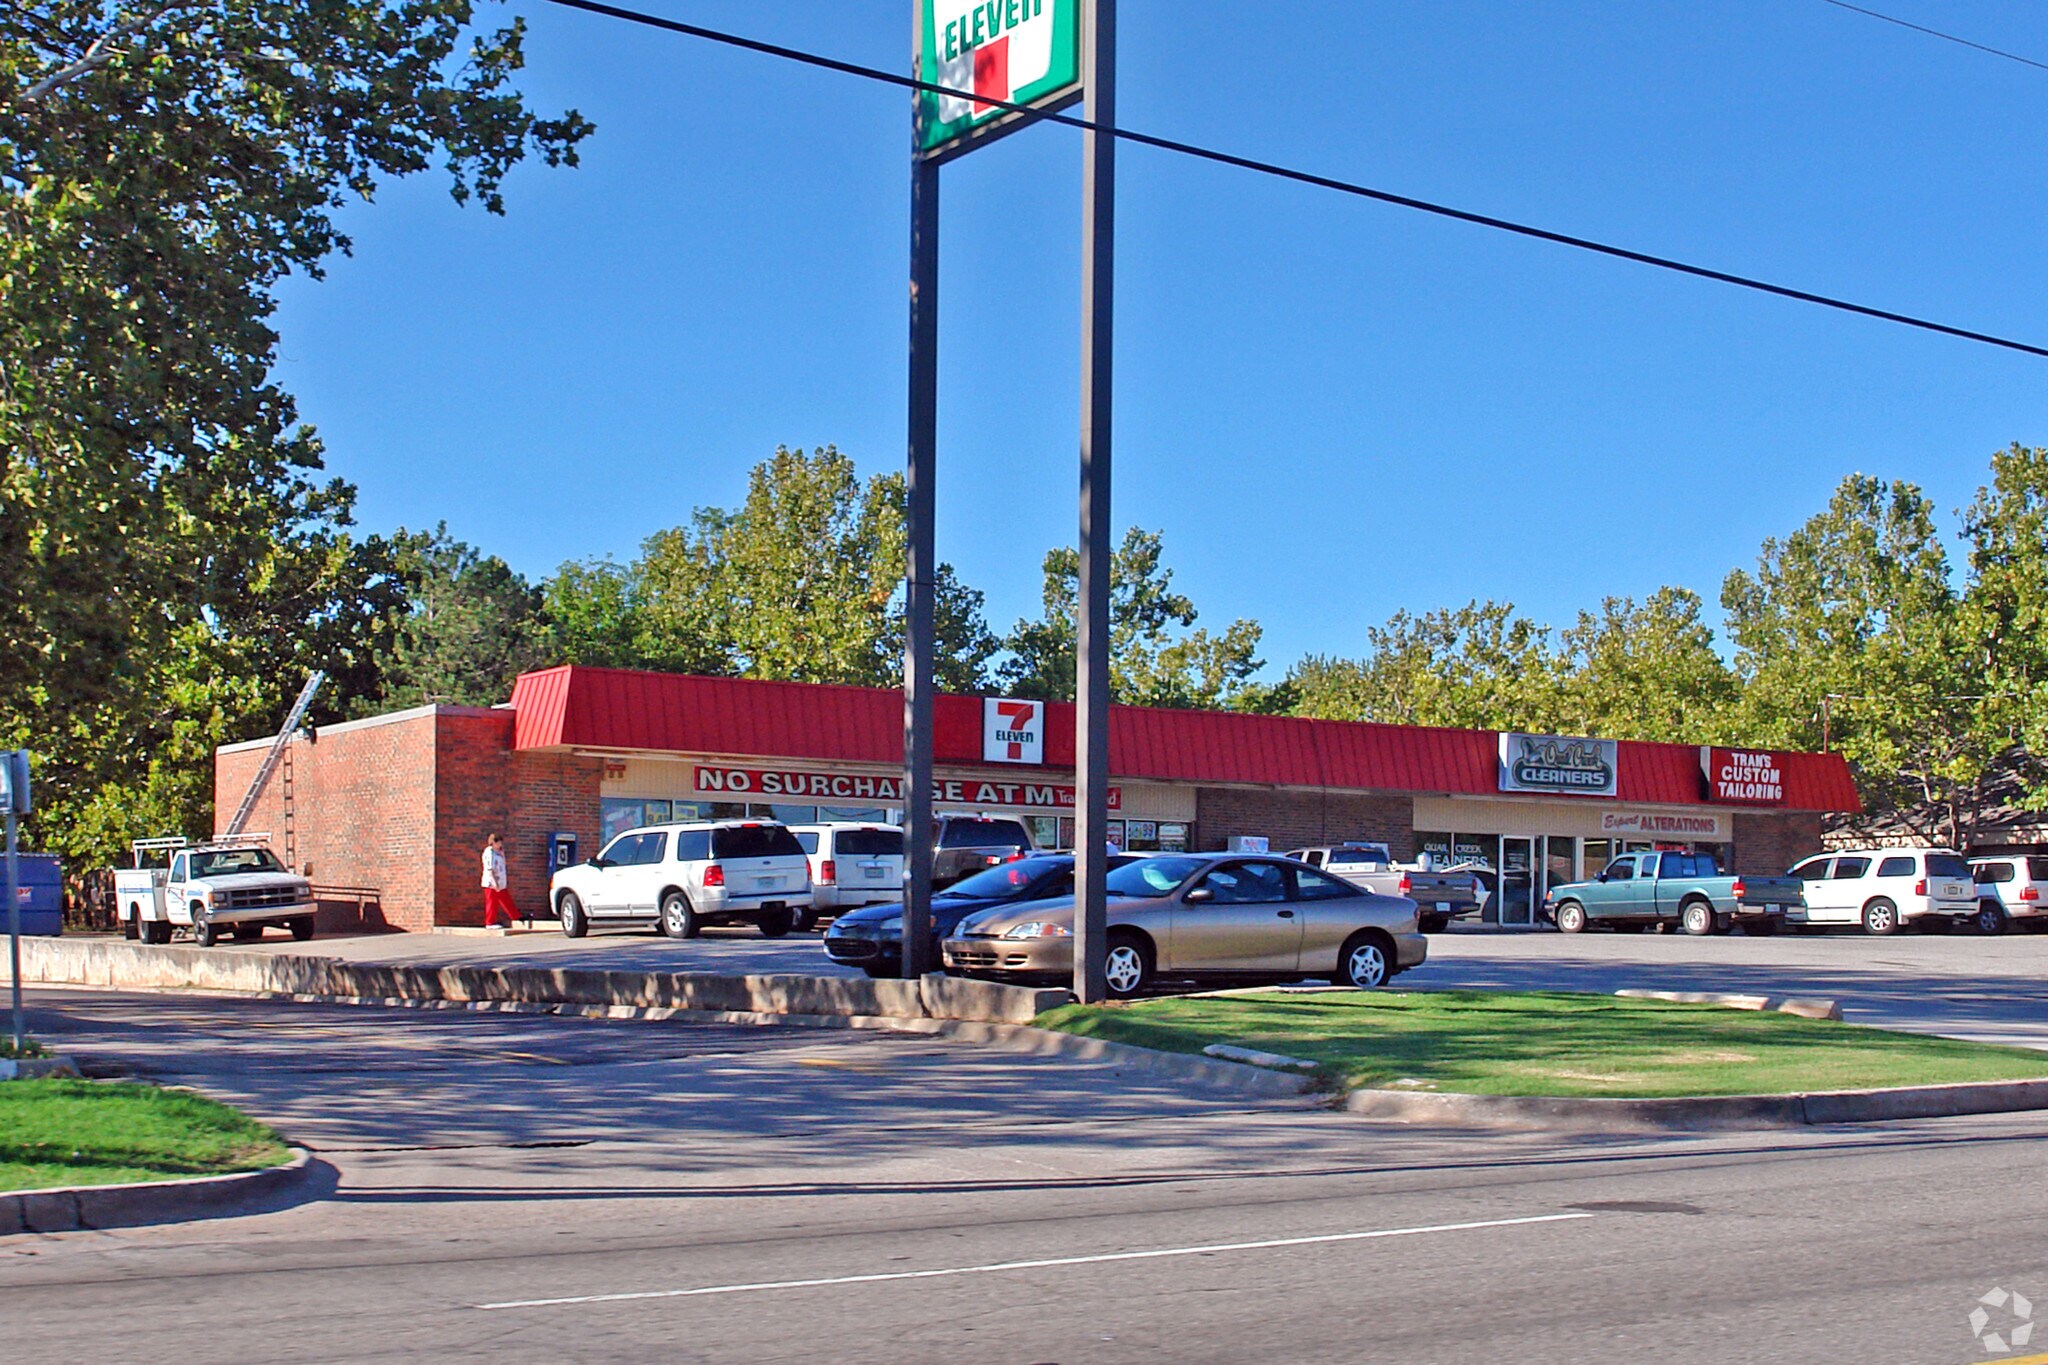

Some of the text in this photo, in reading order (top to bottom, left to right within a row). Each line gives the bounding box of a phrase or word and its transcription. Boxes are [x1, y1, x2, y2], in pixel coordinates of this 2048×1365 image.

[997, 702, 1034, 760] 7
[1731, 752, 1771, 768] TRAN'S
[1521, 768, 1605, 785] CLEANERS
[1721, 765, 1780, 784] CUSTOM
[699, 769, 750, 791] NO
[975, 784, 1055, 805] ATM
[1718, 781, 1783, 800] TAILORING
[1640, 816, 1715, 833] ALTERATIONS
